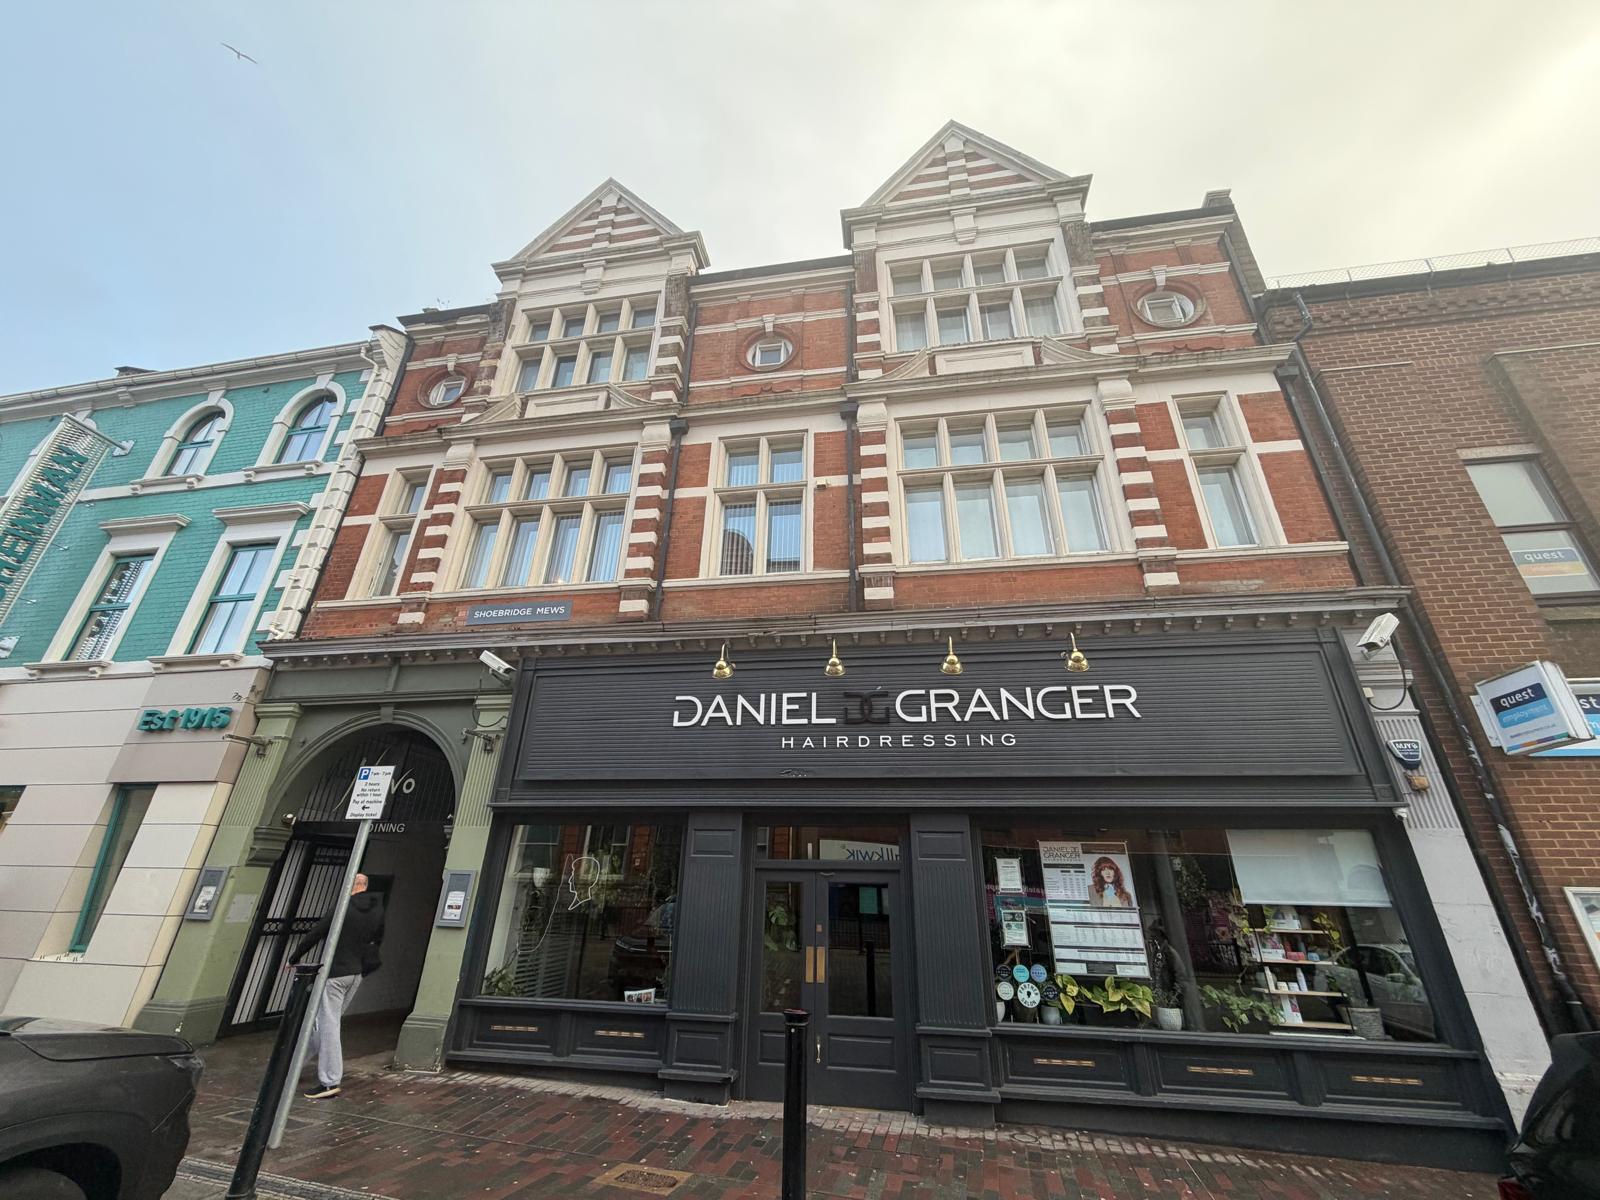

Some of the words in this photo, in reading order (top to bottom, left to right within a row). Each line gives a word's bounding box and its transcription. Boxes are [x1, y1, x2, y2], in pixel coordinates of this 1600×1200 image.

[1524, 551, 1565, 562] quest
[473, 607, 532, 619] SHOEBRIDGE
[536, 606, 565, 615] MEWS
[672, 692, 836, 727] DANIEL
[895, 685, 1142, 722] GRANGER
[1500, 687, 1535, 708] quest
[137, 708, 180, 732] Est
[179, 706, 233, 730] 1915
[781, 733, 1017, 750] HAIRDRESSING
[361, 769, 369, 779] P
